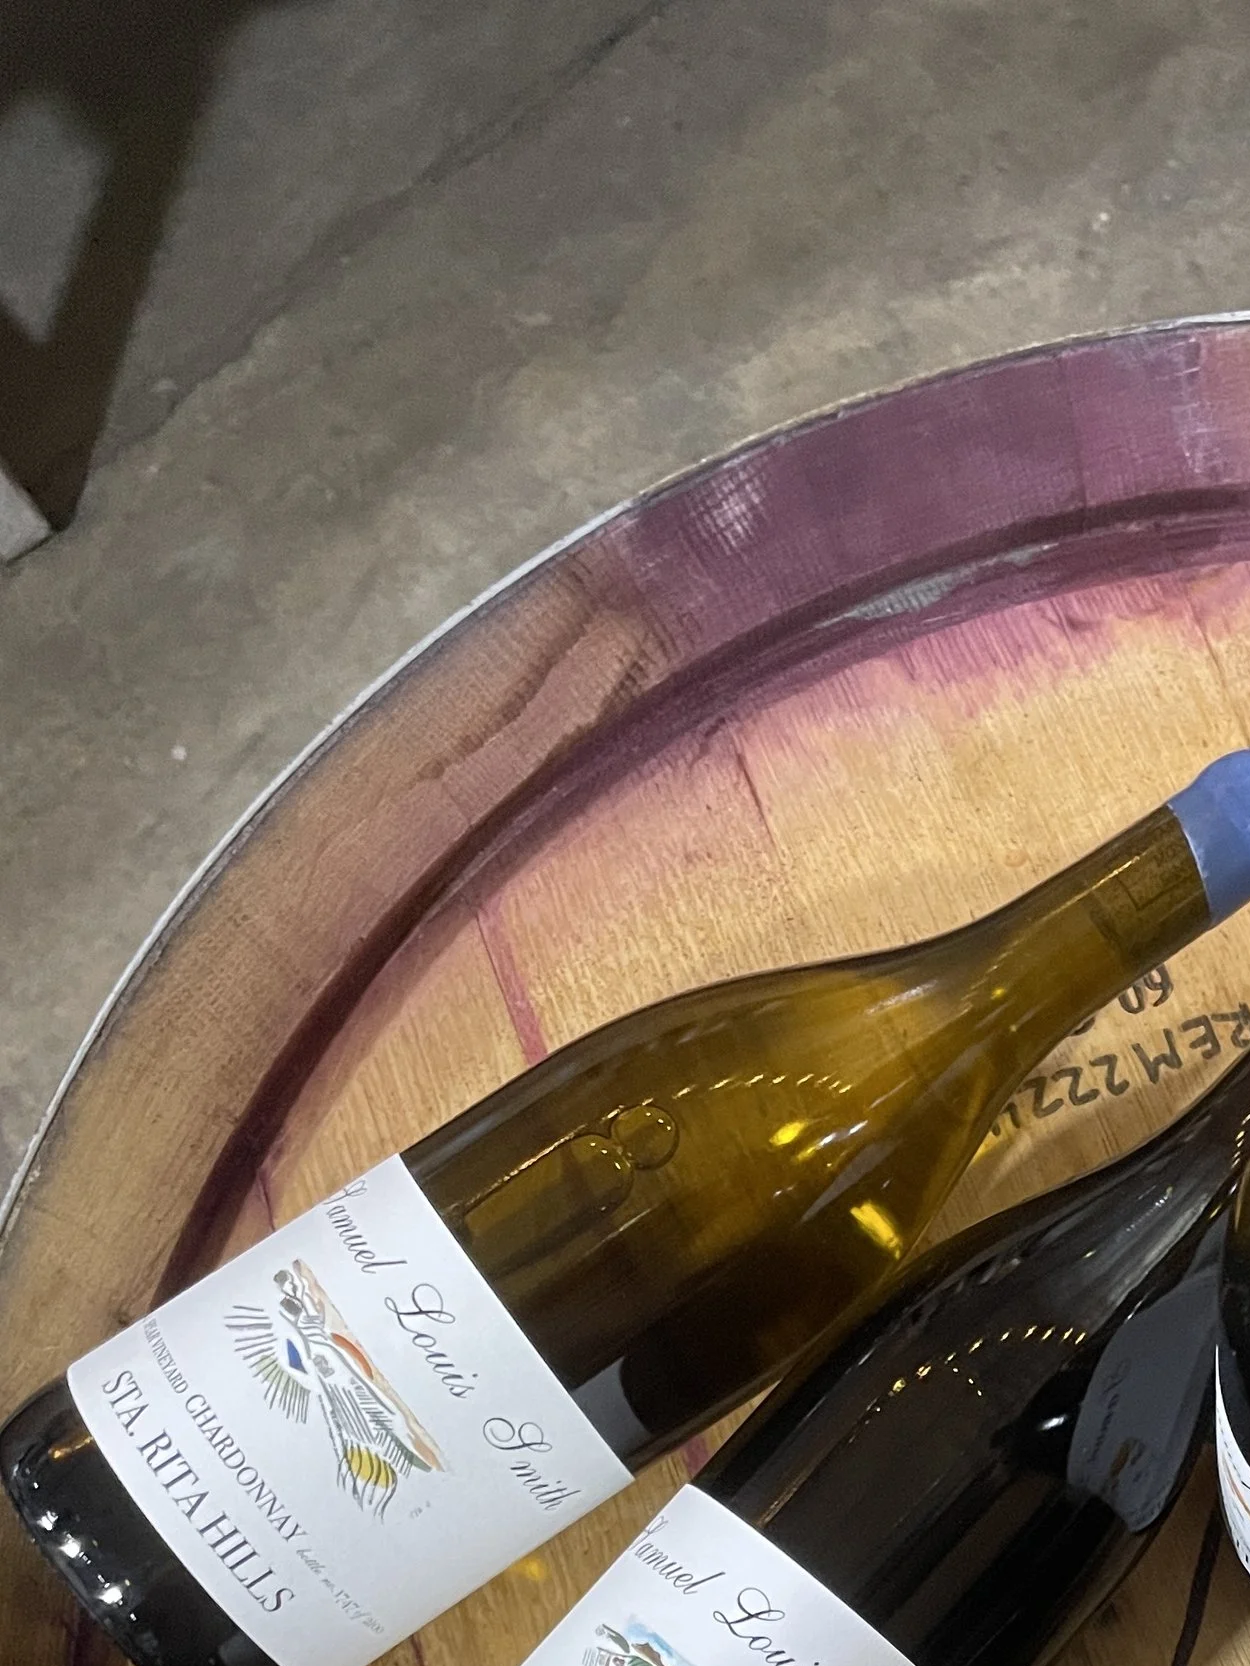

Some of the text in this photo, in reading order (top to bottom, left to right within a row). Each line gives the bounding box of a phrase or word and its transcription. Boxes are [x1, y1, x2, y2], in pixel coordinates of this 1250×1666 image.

[102, 1370, 296, 1613] STA. RITA HILLS
[151, 1334, 188, 1394] VINEYARD
[185, 1393, 308, 1542] CHARDONNAY
[384, 1283, 479, 1399] Louis
[483, 1417, 581, 1511] Smith
[630, 1515, 726, 1595] Samuel
